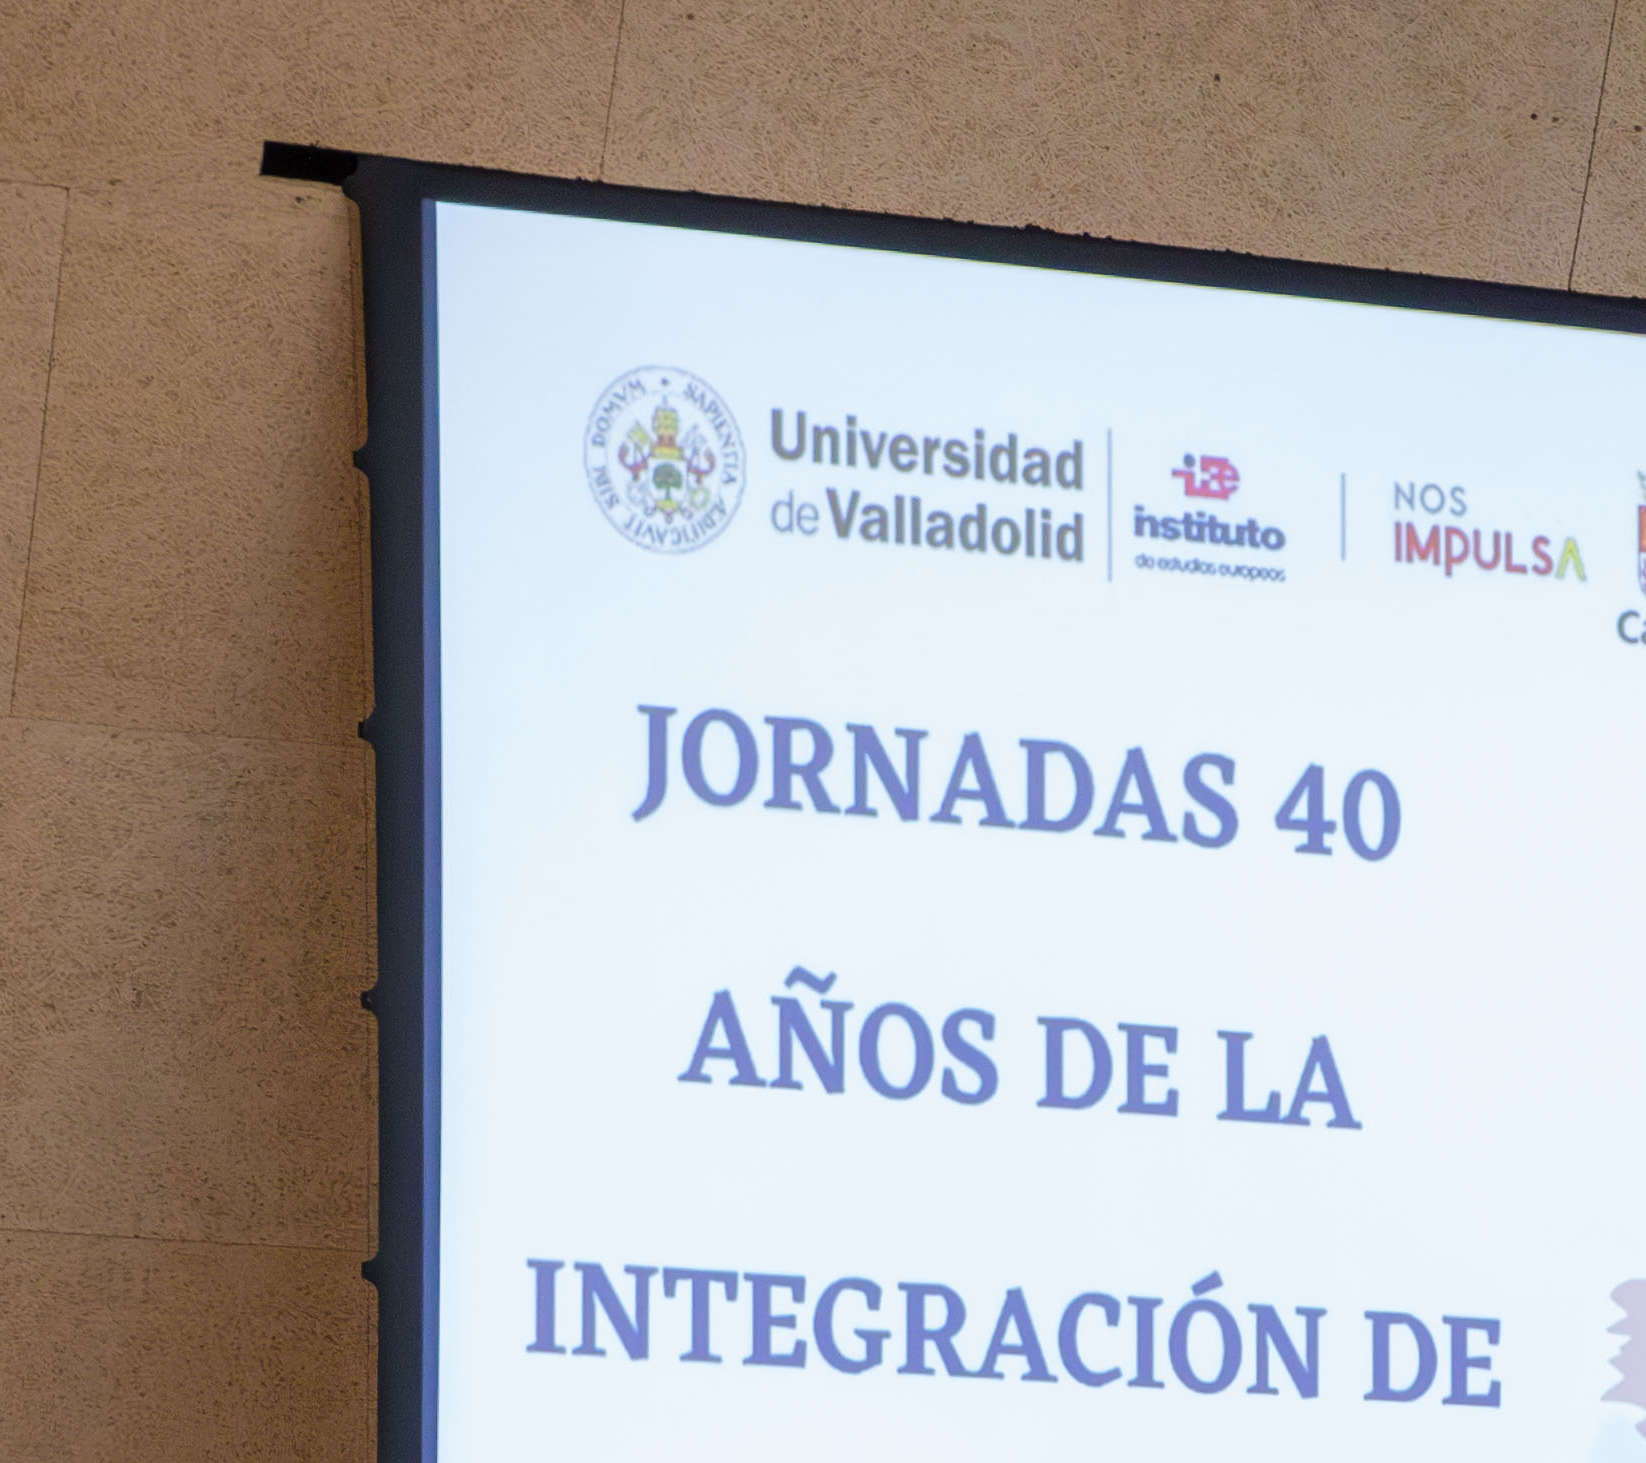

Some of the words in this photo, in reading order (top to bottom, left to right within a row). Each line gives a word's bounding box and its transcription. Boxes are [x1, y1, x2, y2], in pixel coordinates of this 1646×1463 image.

[770, 407, 1084, 491] Universidad
[770, 489, 820, 537] de
[825, 486, 1084, 563] Valladolid
[1133, 504, 1287, 551] instituto
[1394, 482, 1467, 517] NOS
[1157, 556, 1217, 575] estudios
[1218, 563, 1287, 583] europeos
[631, 704, 1239, 849] JORNADAS
[1274, 762, 1402, 862] 40
[677, 965, 999, 1106] AÑOS
[1036, 1016, 1179, 1117] DE
[1216, 1029, 1363, 1131] LA
[526, 1258, 1328, 1400] INTEGRACIÓN
[1363, 1310, 1502, 1408] DE
